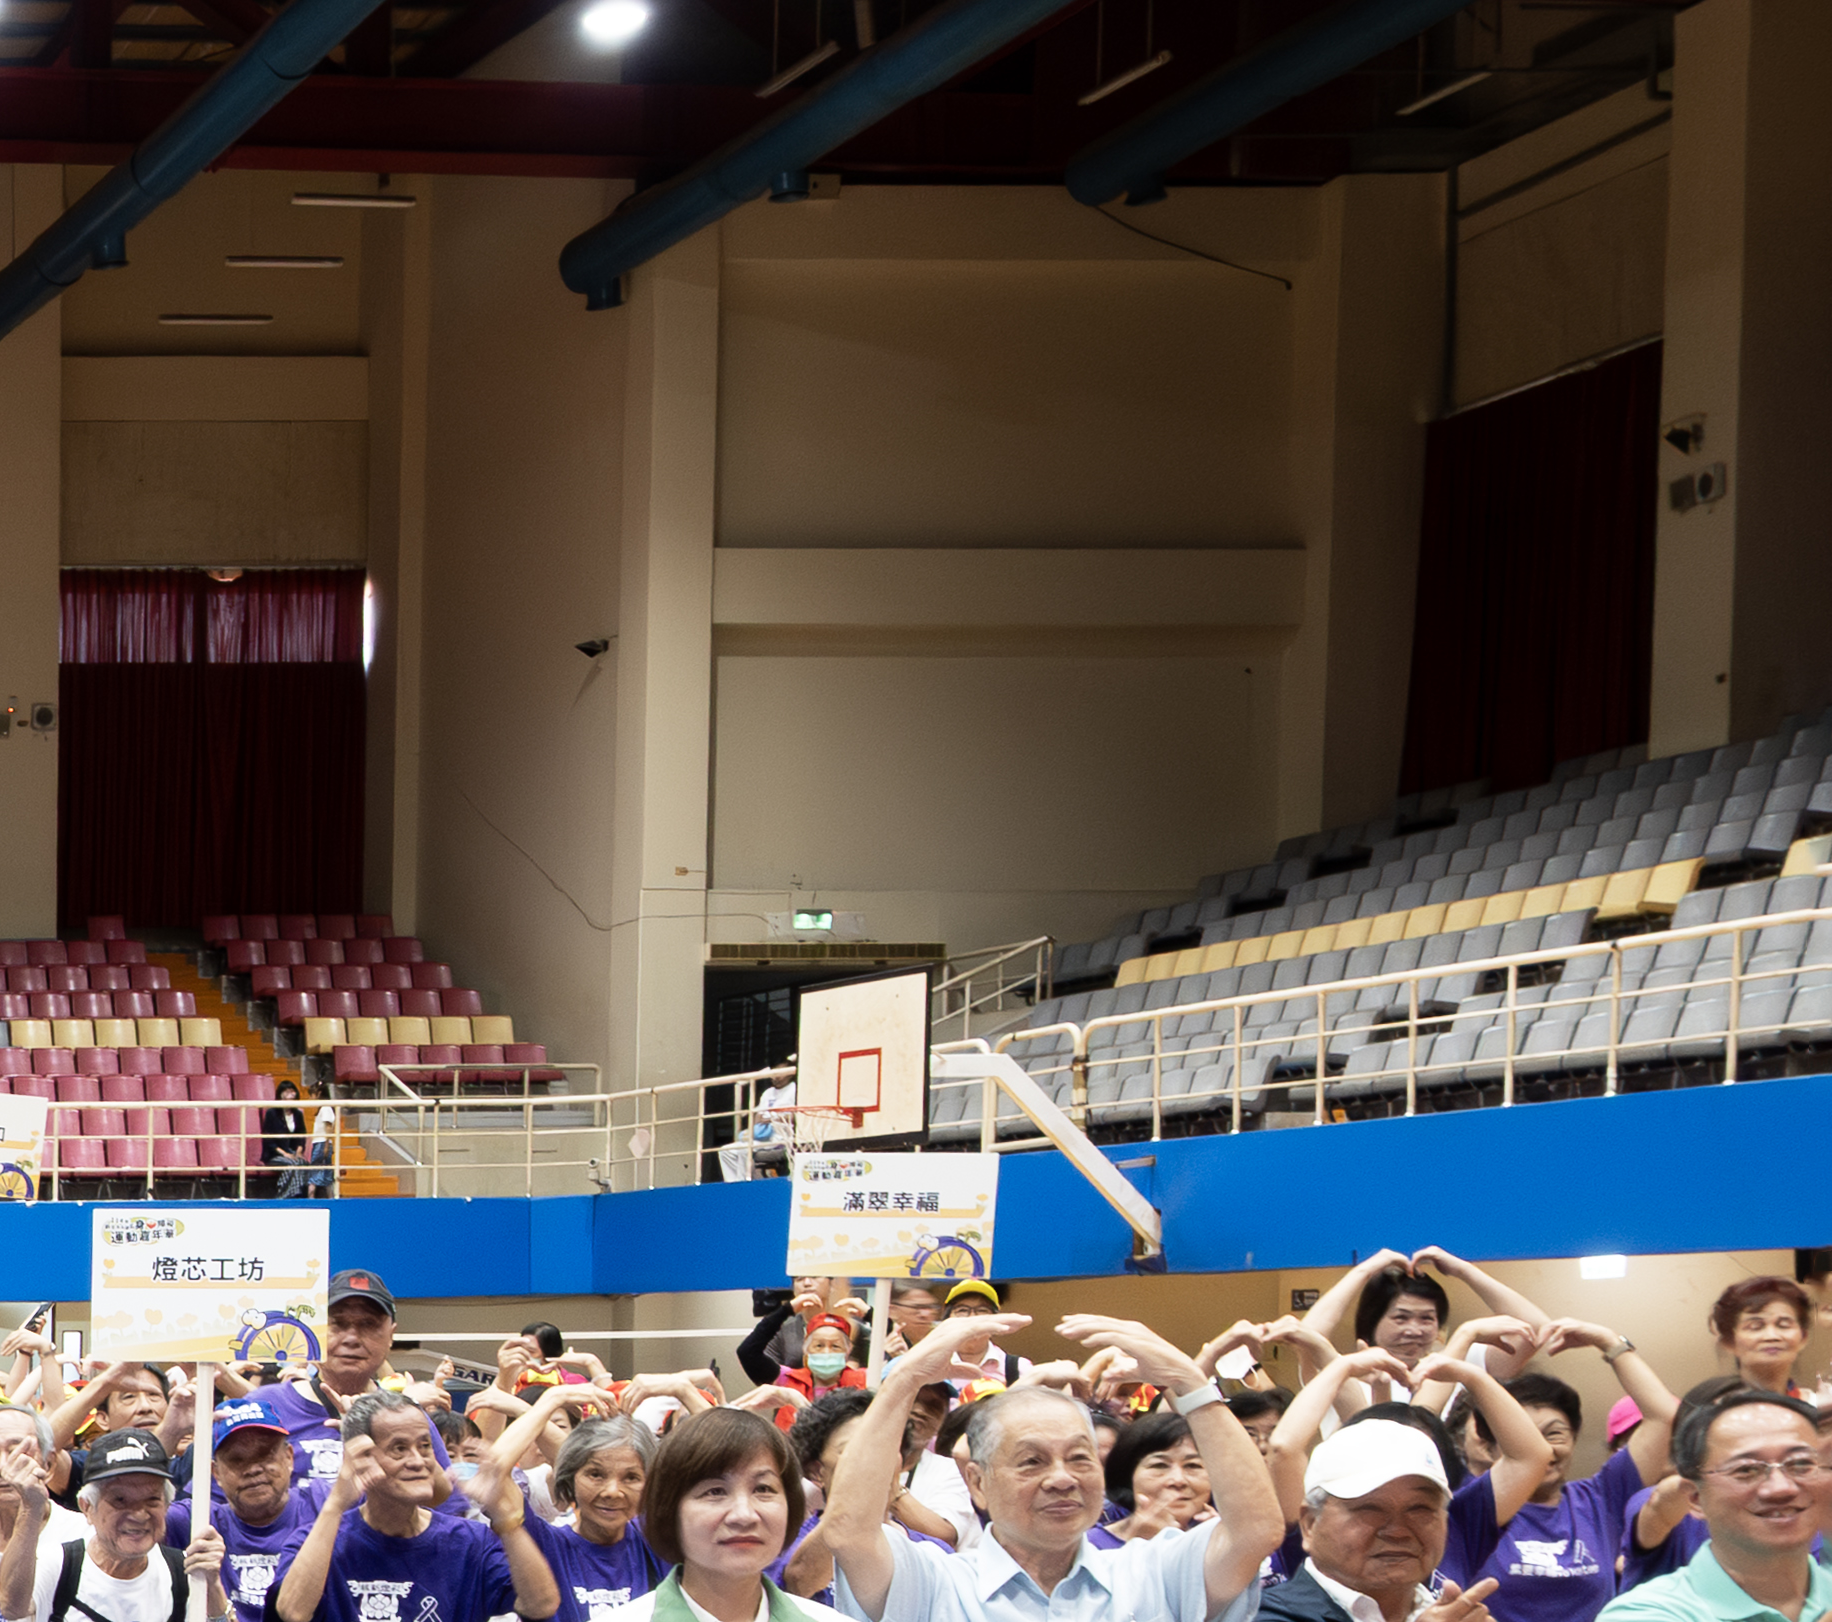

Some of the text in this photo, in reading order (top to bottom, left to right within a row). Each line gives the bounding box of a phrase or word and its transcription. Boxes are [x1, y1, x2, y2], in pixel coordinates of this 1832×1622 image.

[843, 1191, 940, 1212] 滿翠幸福
[152, 1256, 265, 1281] 燈芯工坊
